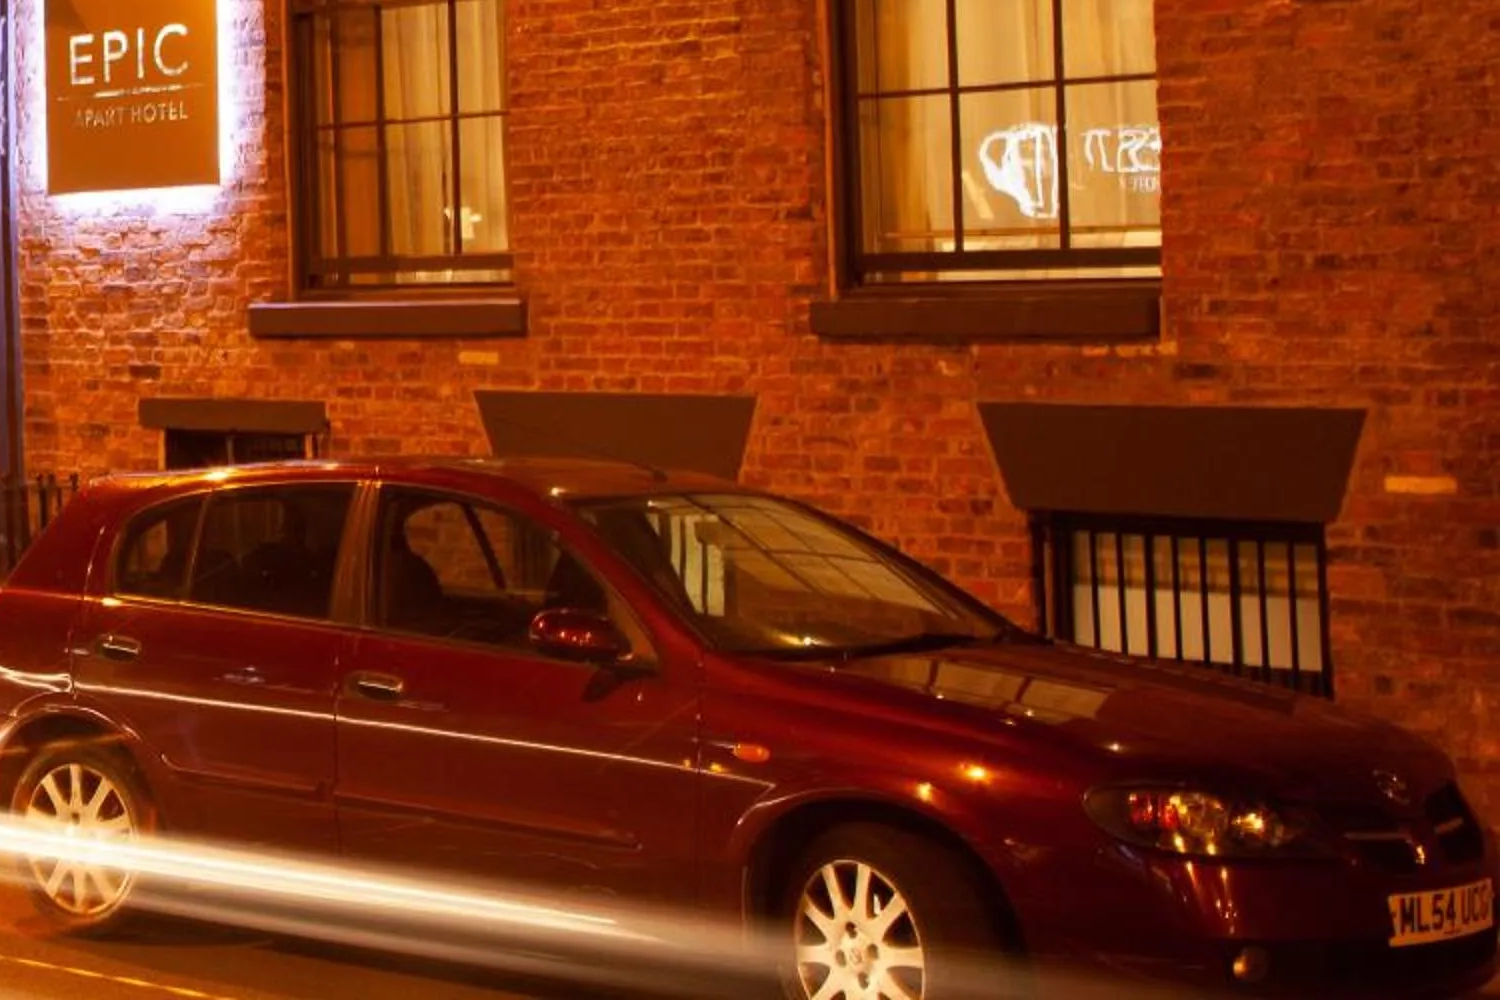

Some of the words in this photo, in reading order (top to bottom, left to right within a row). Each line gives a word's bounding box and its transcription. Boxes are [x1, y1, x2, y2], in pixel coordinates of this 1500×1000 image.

[69, 23, 189, 86] EPIC
[74, 107, 125, 128] APART
[130, 101, 189, 124] HOTEL
[1399, 889, 1457, 937] ML54
